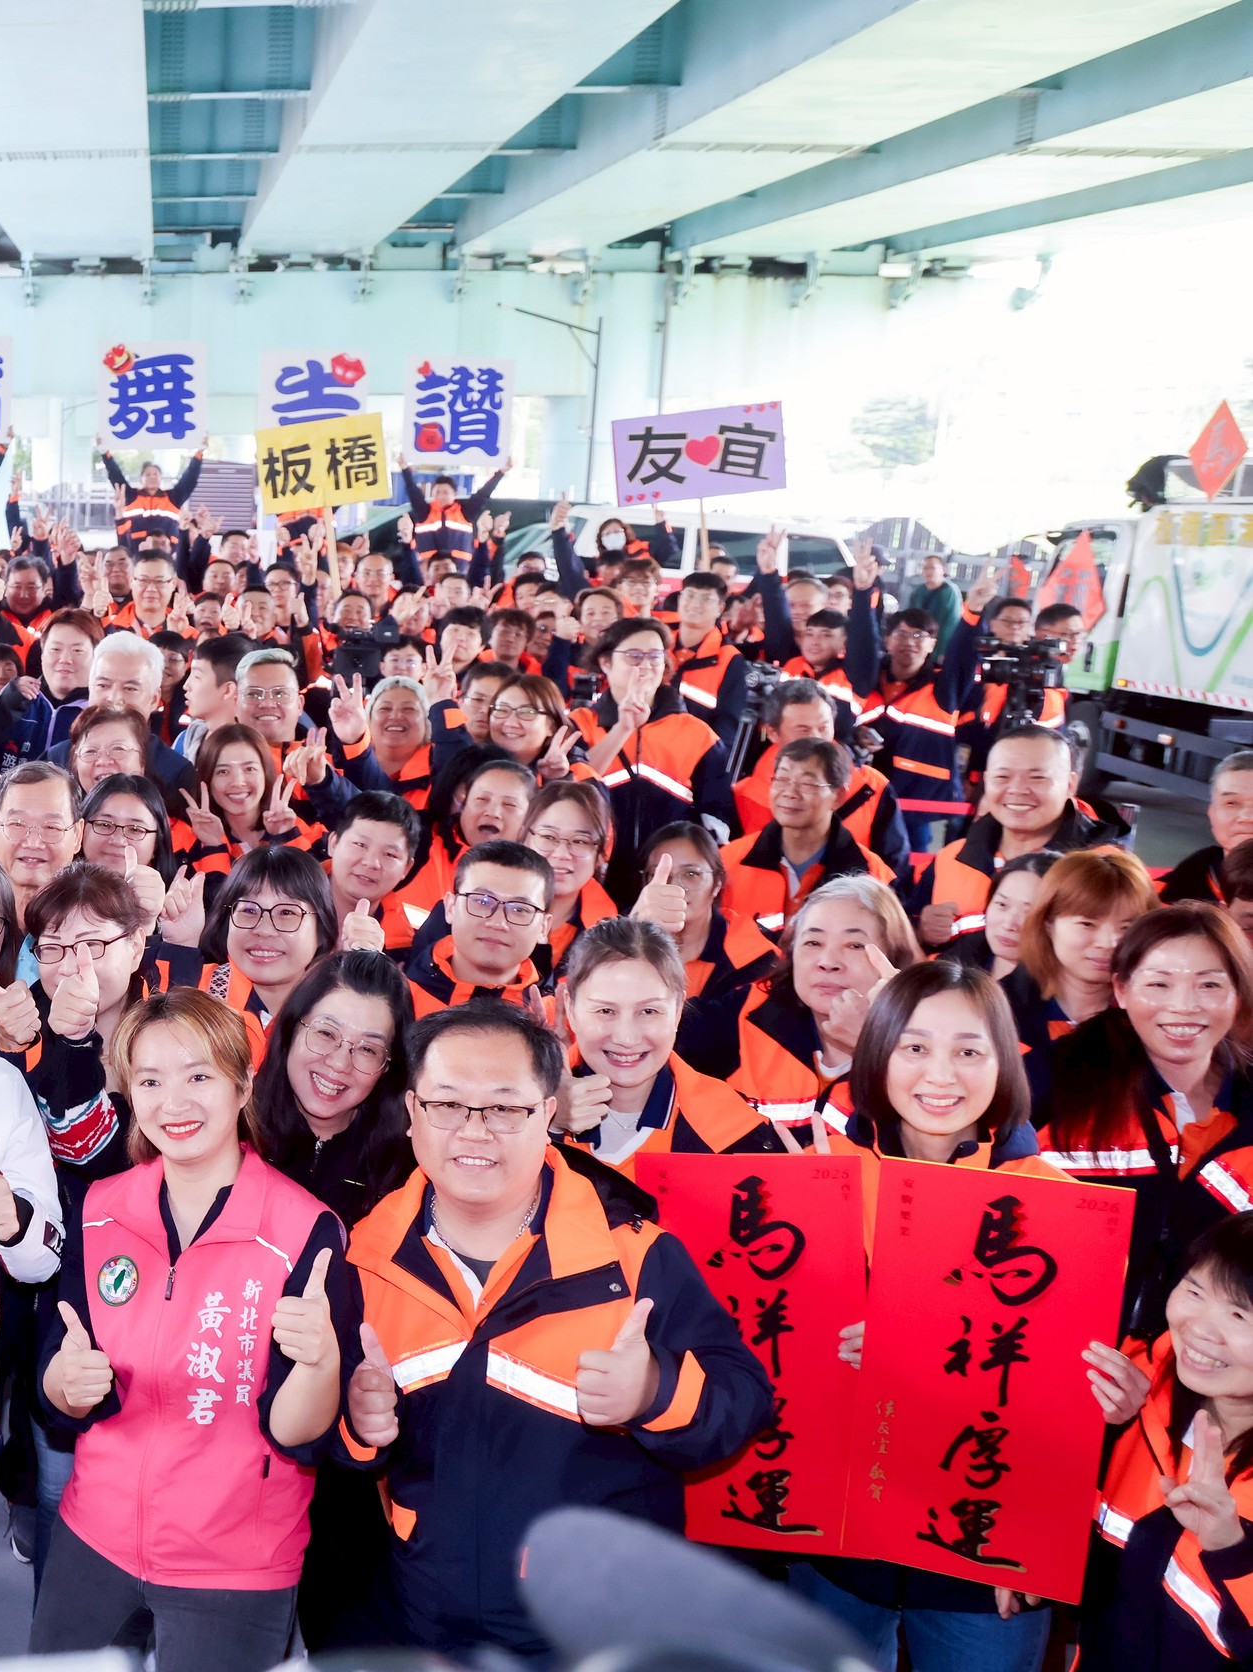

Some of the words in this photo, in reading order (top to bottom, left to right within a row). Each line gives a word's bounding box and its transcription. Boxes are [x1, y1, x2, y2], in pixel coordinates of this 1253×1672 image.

[108, 353, 196, 441] 舞
[412, 365, 505, 457] 讚
[626, 422, 777, 485] 友宜
[262, 434, 379, 499] 板橋
[1074, 1197, 1123, 1214] 2026
[186, 1291, 232, 1425] 黃淑君
[235, 1278, 264, 1407] 新北市議員
[915, 1195, 1059, 1574] 馬祥厚運
